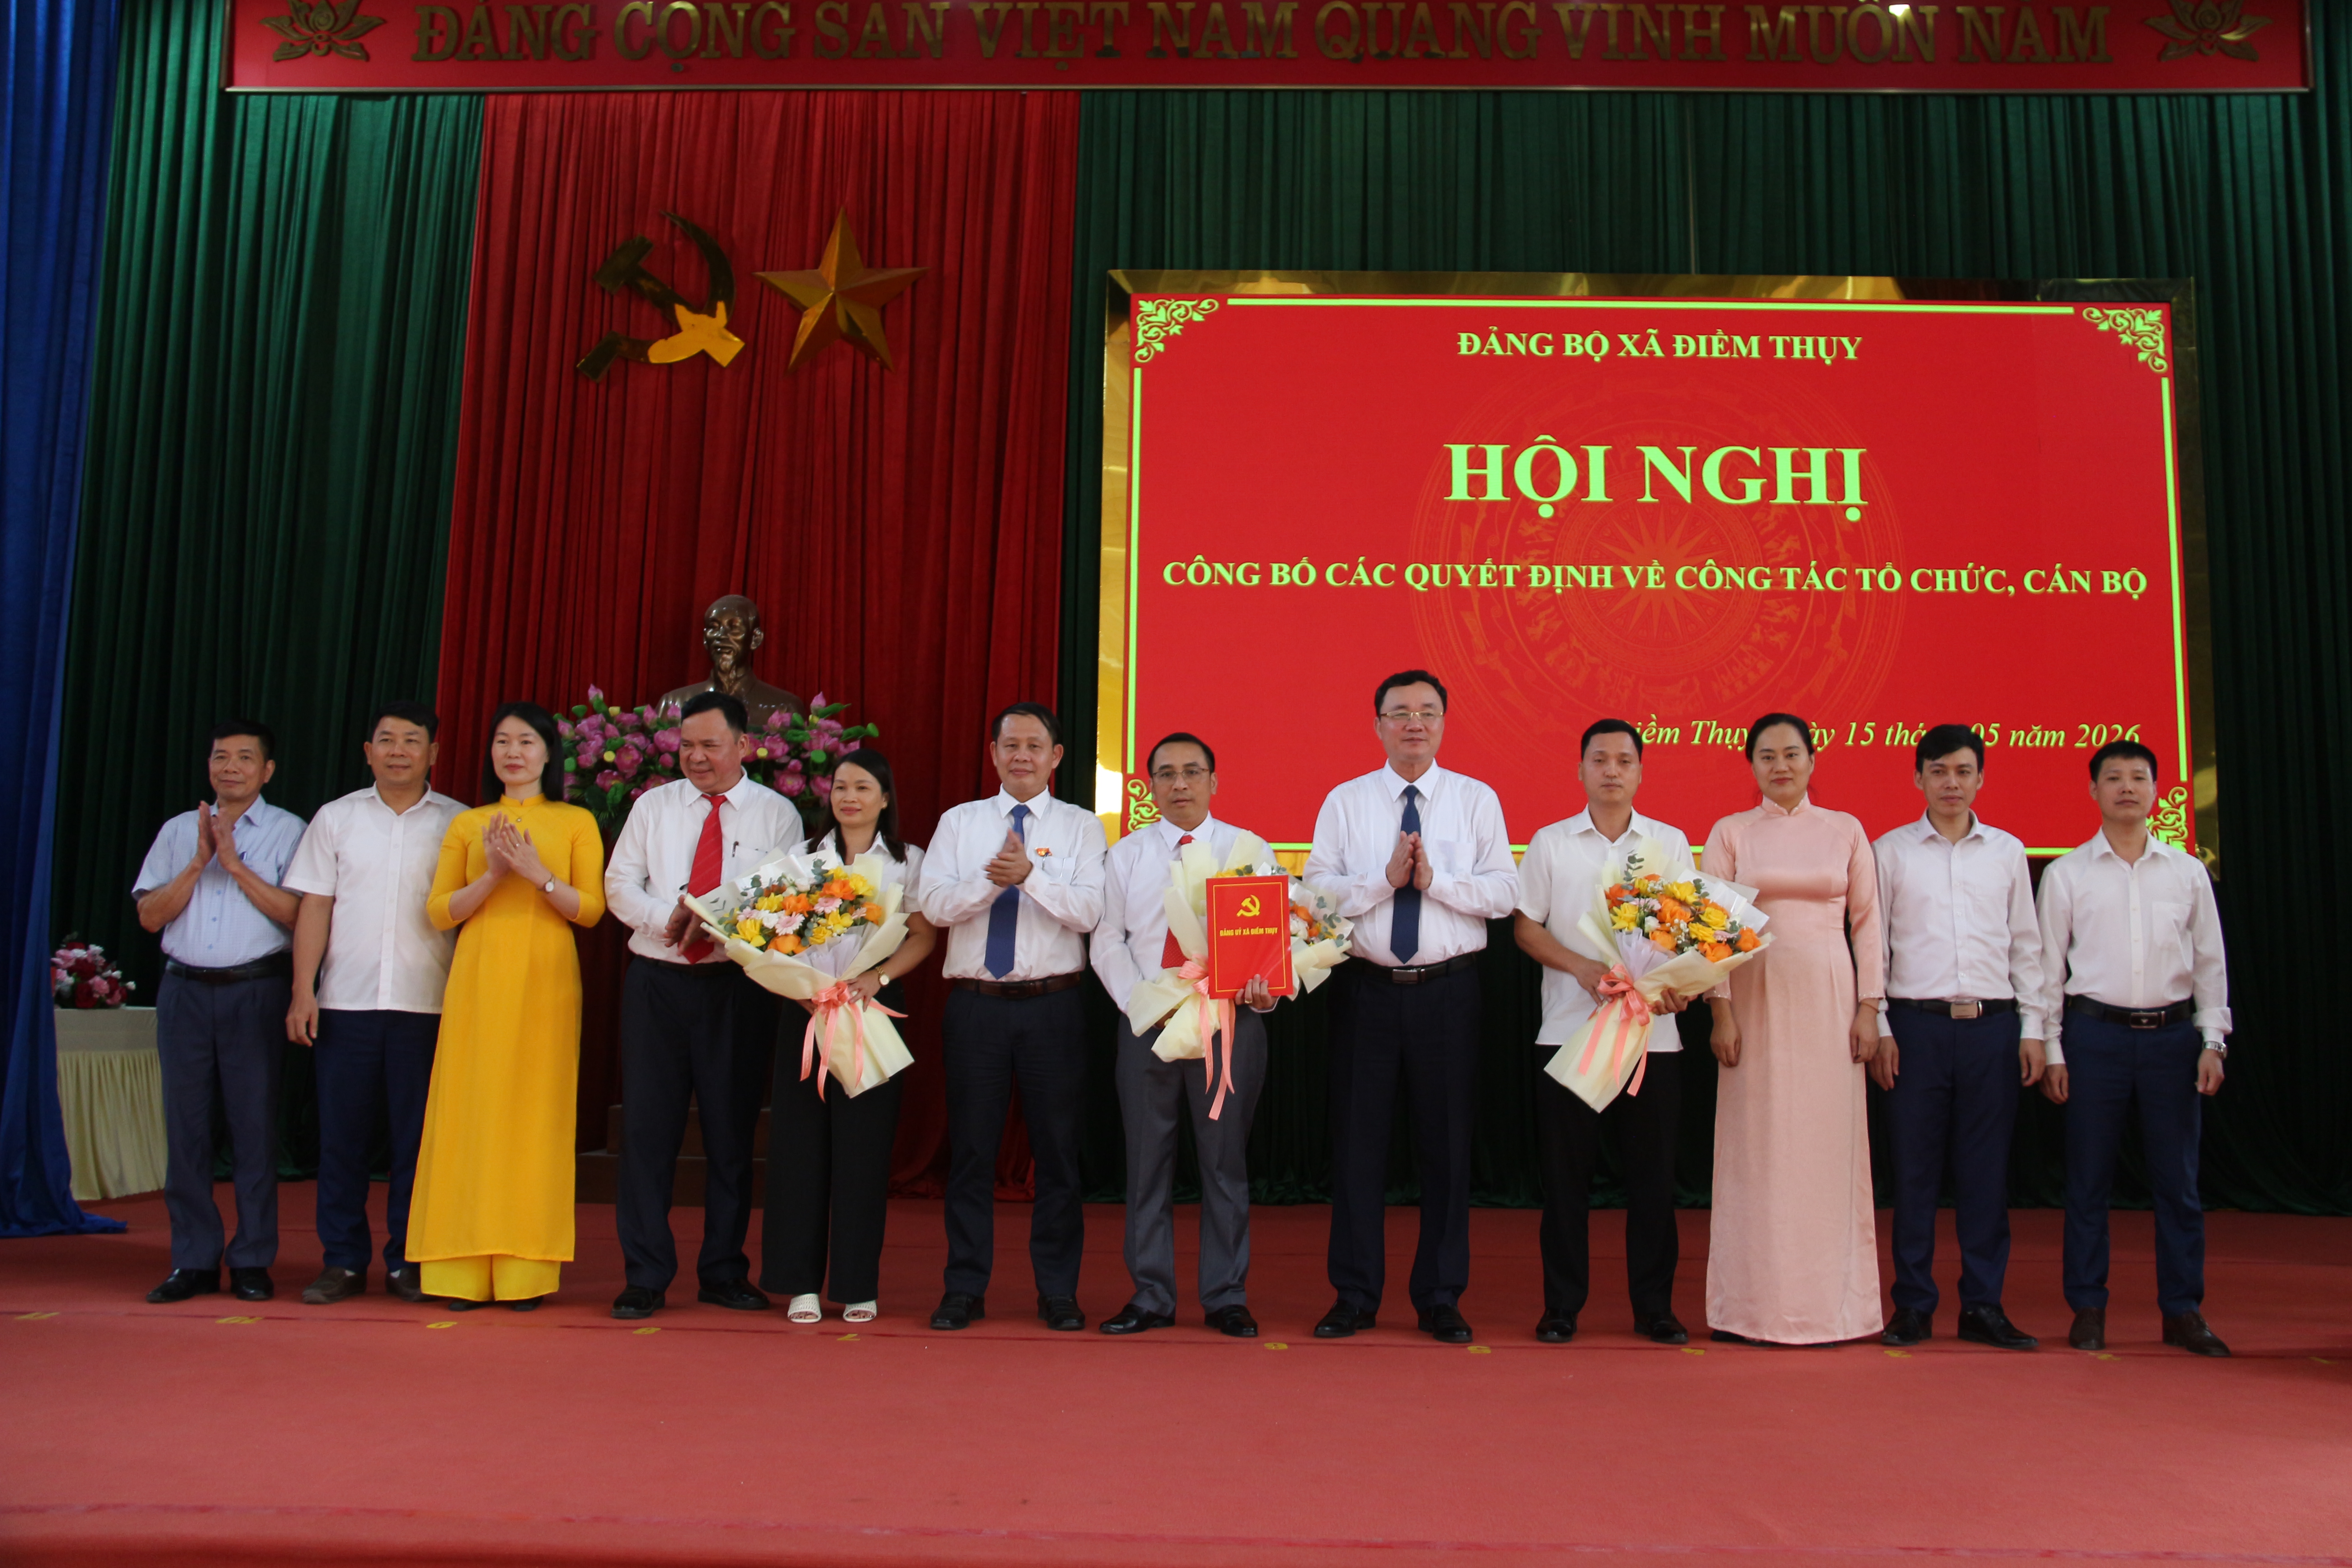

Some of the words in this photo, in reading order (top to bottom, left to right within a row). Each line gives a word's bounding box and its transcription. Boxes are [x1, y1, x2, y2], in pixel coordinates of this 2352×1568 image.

[1146, 3, 1298, 59] NAM
[1314, 0, 1543, 63] QUANG
[1553, 3, 1726, 61] VINH
[1457, 326, 1553, 357] ĐẢNG
[1563, 330, 1610, 363] BỘ
[1617, 328, 1665, 358] XÃ
[1672, 329, 1761, 358] ĐIỀM
[1769, 336, 1862, 365] THỤY
[1444, 434, 1613, 519] HỘI
[1636, 446, 1868, 522] NGHỊ
[1162, 554, 1261, 587] CÔNG
[1269, 556, 1317, 587] BỐ
[1325, 556, 1396, 587] CÁC
[1404, 558, 1521, 592] QUYẾT
[1528, 564, 1614, 594] ĐỊNH
[1621, 559, 1666, 589] VỀ
[1674, 559, 1772, 591] CÔNG
[1779, 560, 1847, 592] TÁC
[1855, 562, 1902, 592] TỔ
[1910, 562, 2015, 596] CHỨC,
[2023, 563, 2091, 593] CÁN
[2101, 567, 2147, 600] BỘ
[1626, 713, 1680, 744] iềm
[1808, 721, 1836, 752] ày
[1845, 722, 1876, 746] 15
[1884, 722, 1927, 747] thá
[2009, 724, 2066, 748] năm
[2074, 723, 2141, 748] 2026
